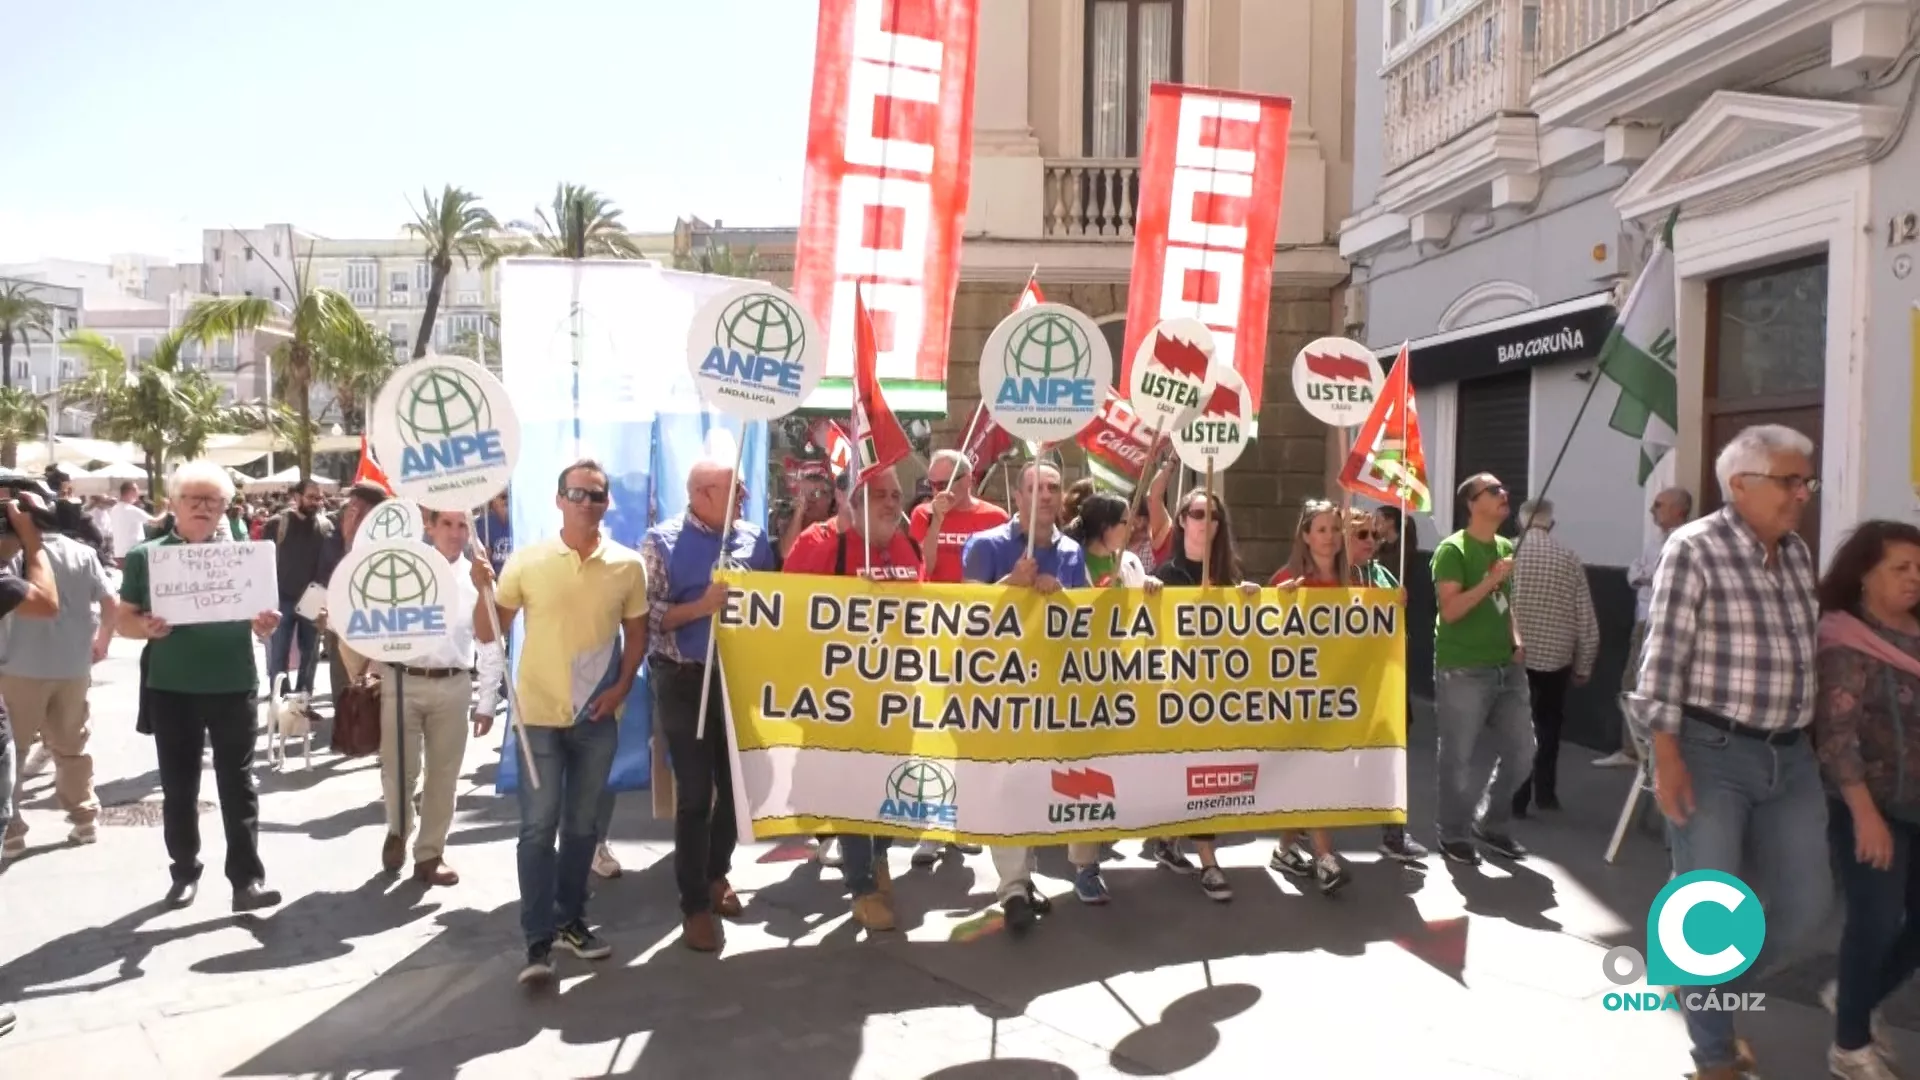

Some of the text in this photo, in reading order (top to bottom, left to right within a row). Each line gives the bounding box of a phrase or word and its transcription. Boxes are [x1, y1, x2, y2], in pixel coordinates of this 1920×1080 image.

[1159, 94, 1260, 367] CCO
[1886, 213, 1917, 247] 12
[1497, 327, 1584, 363] BAR CORUÑA
[700, 347, 804, 390] ANPE
[718, 386, 776, 405] ANDALUCÍA
[995, 377, 1096, 406] ANPE
[1141, 371, 1201, 408] USTEA
[1307, 383, 1374, 402] USTEA
[1016, 414, 1073, 425] ANDALUCÍA
[1181, 422, 1240, 444] USTEA
[401, 430, 506, 477] ANPE
[244, 579, 252, 588] A
[347, 605, 447, 634] ANPE
[720, 591, 1396, 638] EN DEFENSA DE LA EDUCACIÓN
[824, 638, 1318, 685] PÚBLICA: AUMENTO DE
[762, 685, 1358, 730] LAS PLANTILLAS DOCENTES
[1191, 771, 1242, 788] CCOO
[879, 799, 958, 822] ANPE
[1048, 802, 1116, 823] USTEA
[1186, 794, 1256, 811] enseñanza
